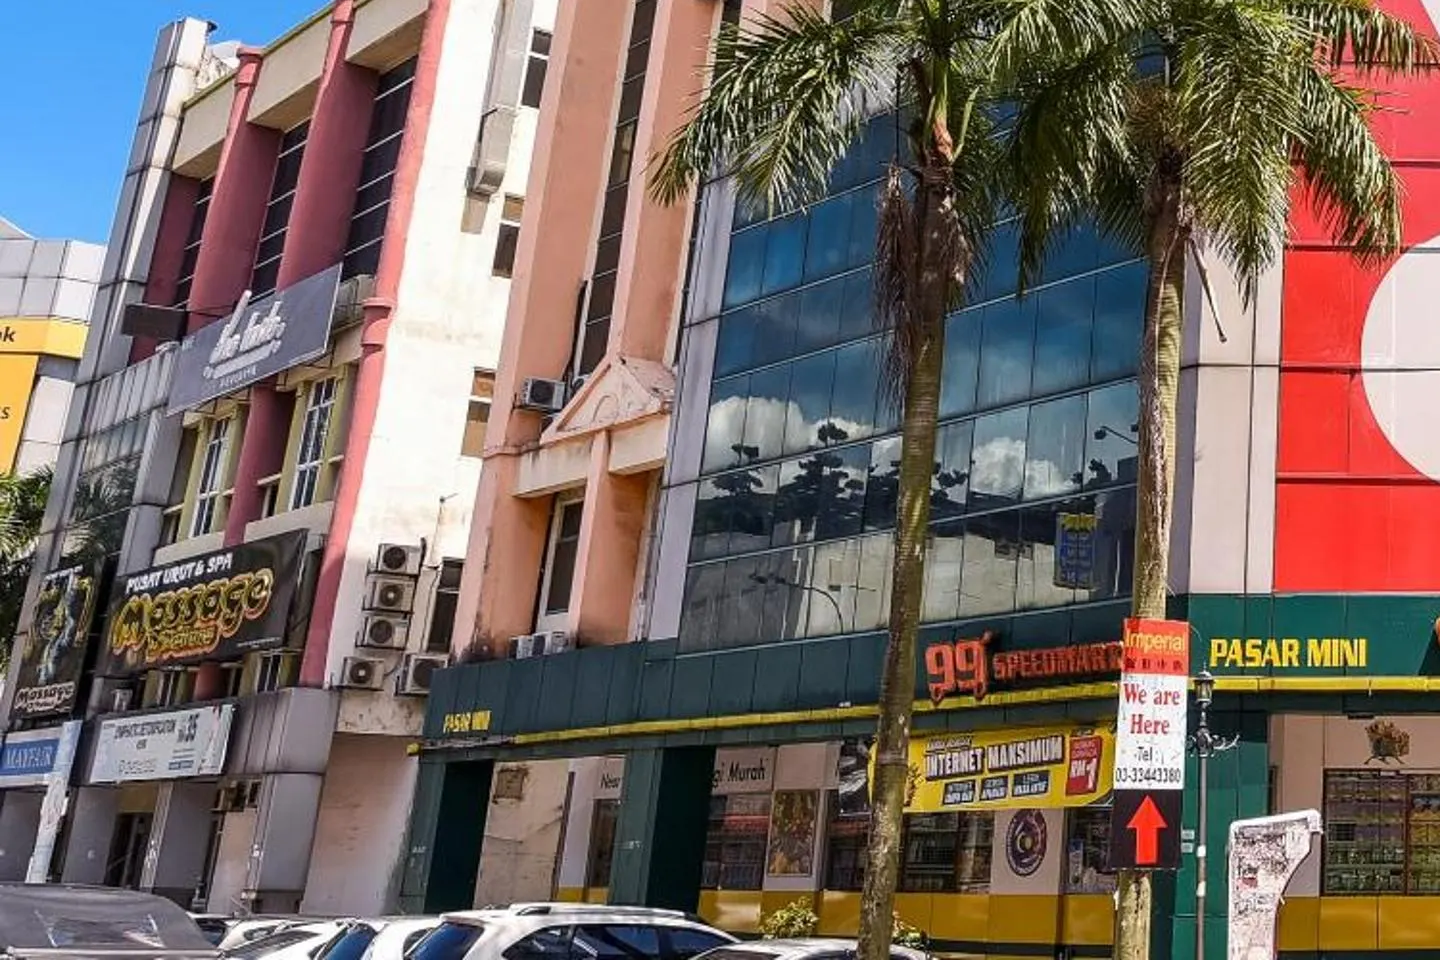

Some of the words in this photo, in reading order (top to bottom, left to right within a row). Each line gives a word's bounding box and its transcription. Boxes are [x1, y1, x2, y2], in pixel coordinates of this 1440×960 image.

[126, 570, 160, 594] PUSAT
[163, 562, 194, 585] URUT
[207, 553, 233, 572] SPA
[1125, 629, 1186, 654] Imperial
[1209, 638, 1300, 667] PASAR
[1307, 638, 1367, 667] MINI
[925, 634, 992, 704] 99
[1123, 683, 1147, 705] We
[1153, 689, 1181, 705] are
[1130, 714, 1170, 735] Here
[728, 757, 765, 782] Murah
[926, 748, 983, 778] INTERNET
[988, 736, 1063, 770] MAKSIMUM
